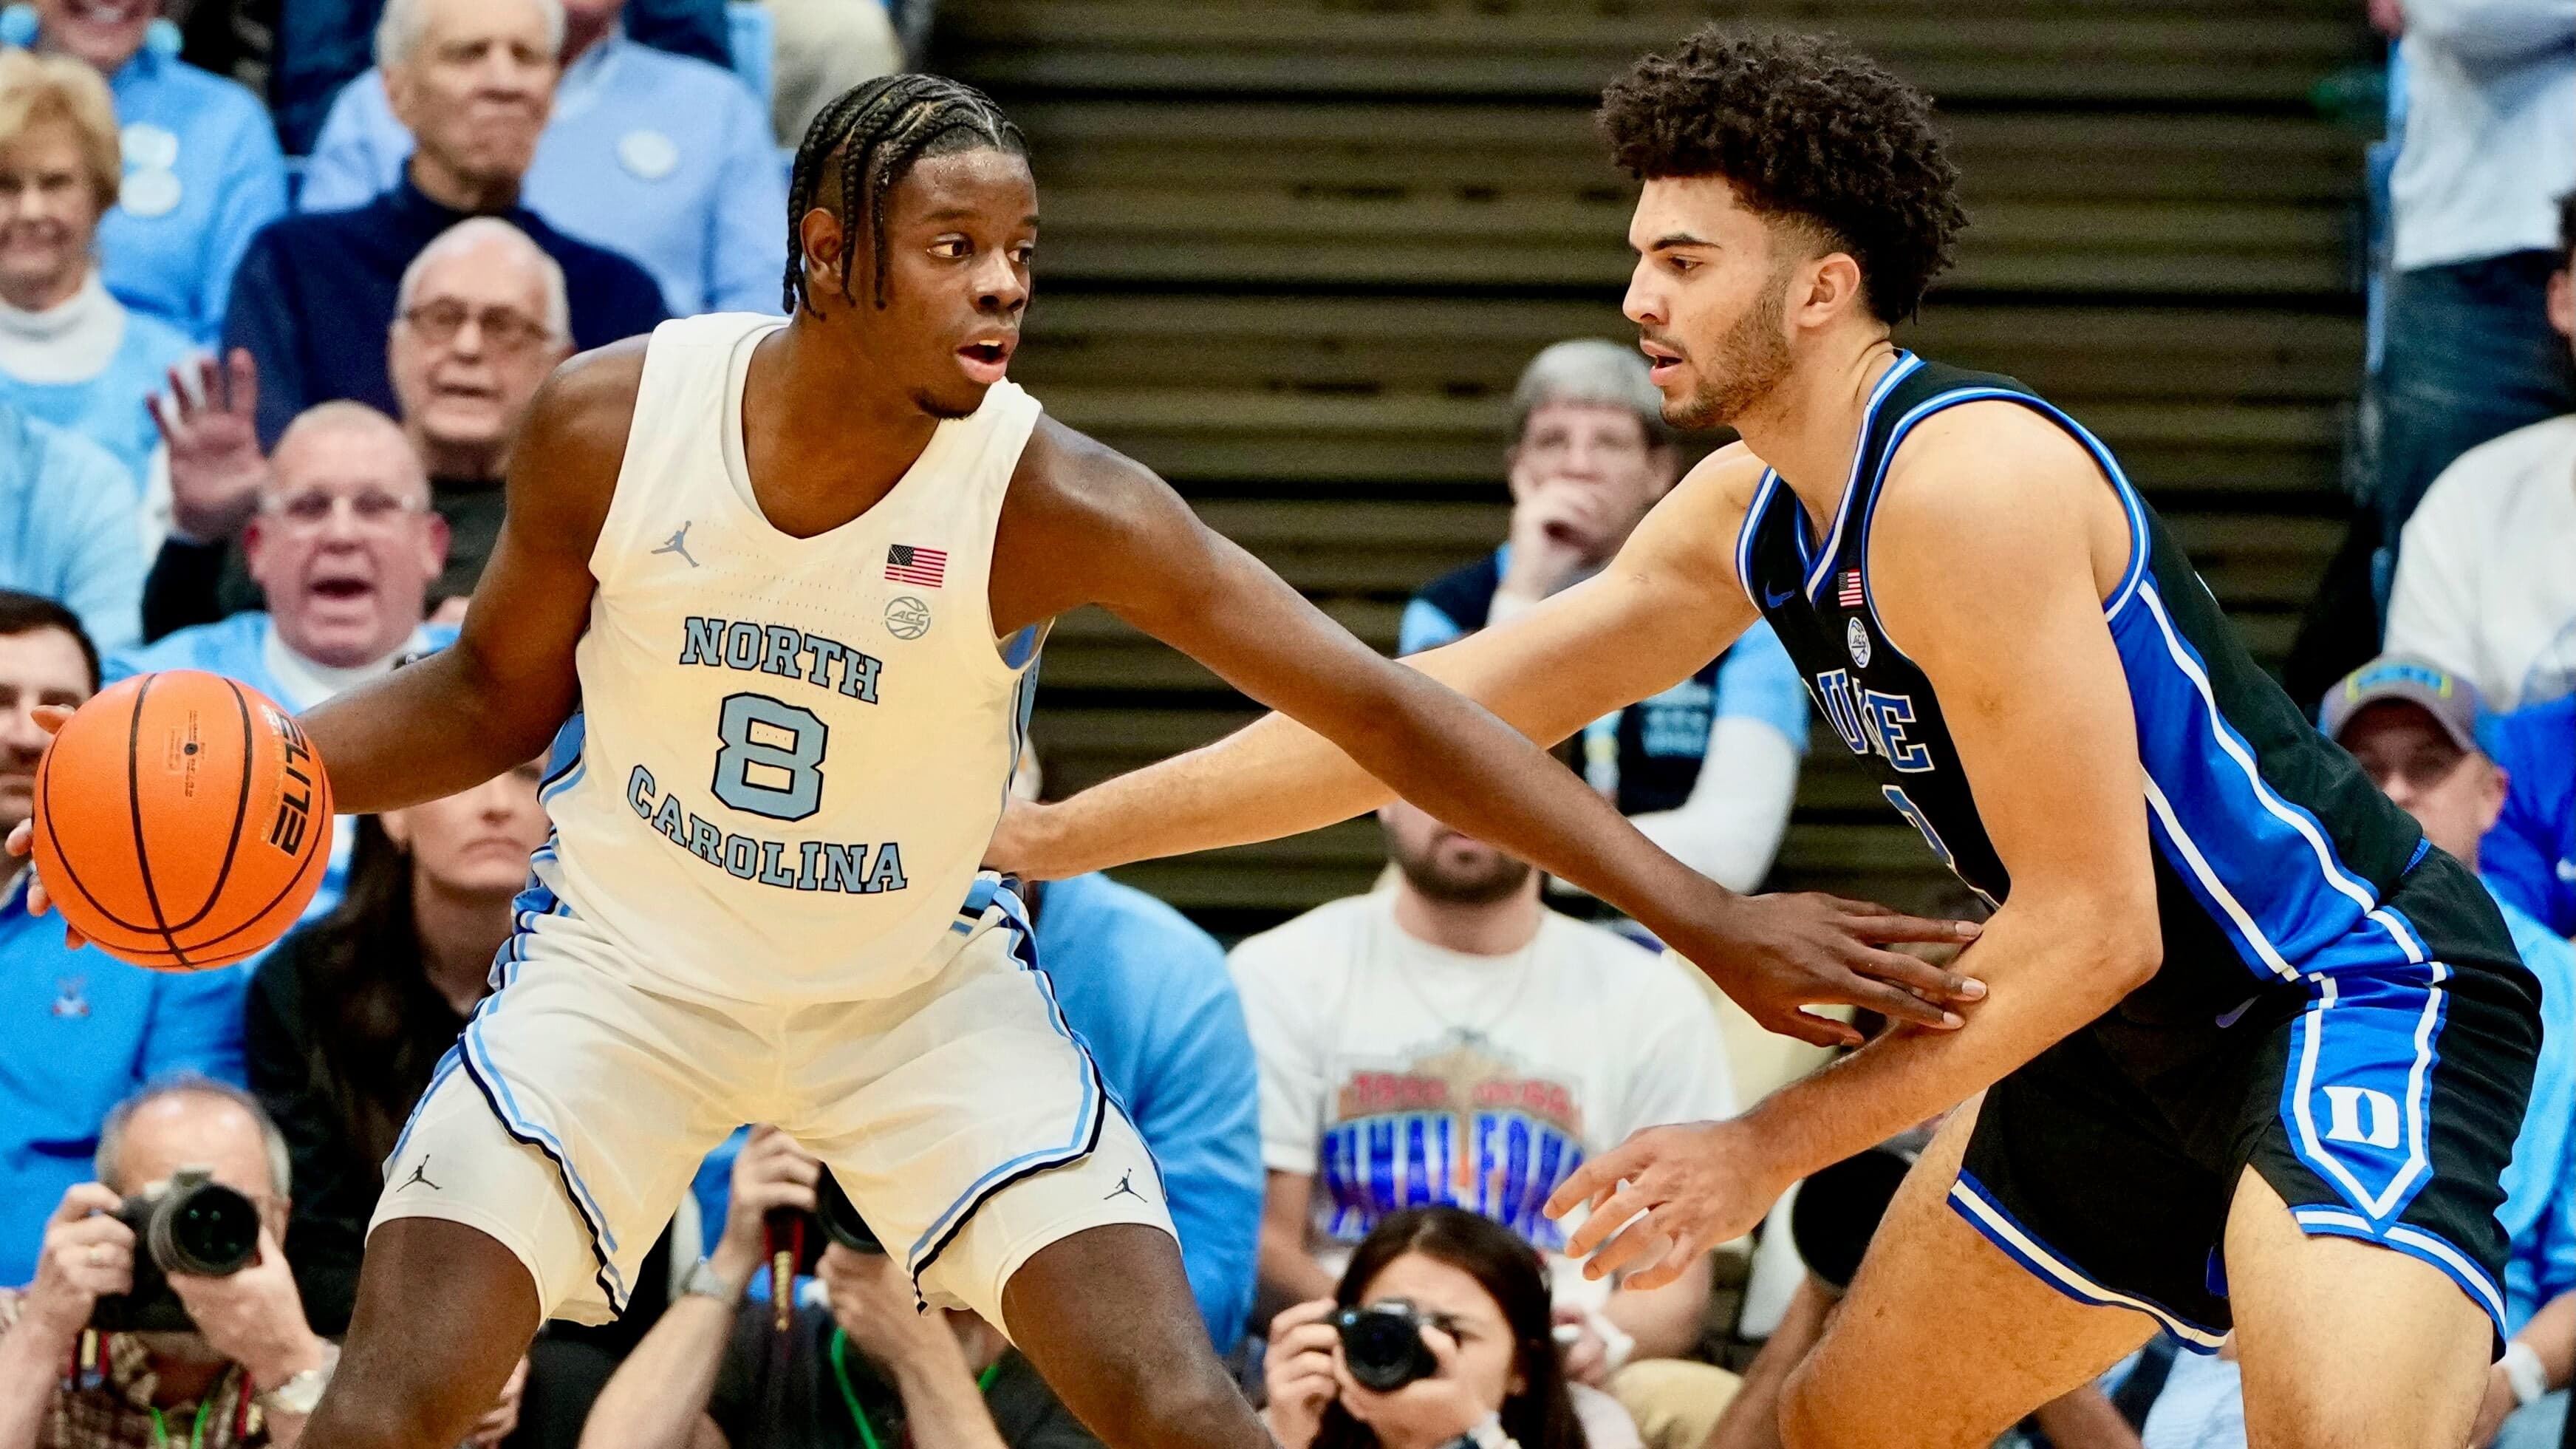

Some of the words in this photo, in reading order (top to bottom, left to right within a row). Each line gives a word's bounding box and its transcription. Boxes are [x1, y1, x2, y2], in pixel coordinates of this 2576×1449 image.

[679, 616, 883, 704] NORTH
[891, 610, 929, 626] ACC
[268, 709, 312, 857] ELITE
[711, 692, 829, 822] 8
[626, 764, 908, 894] CAROLINA
[2322, 1085, 2399, 1150] D
